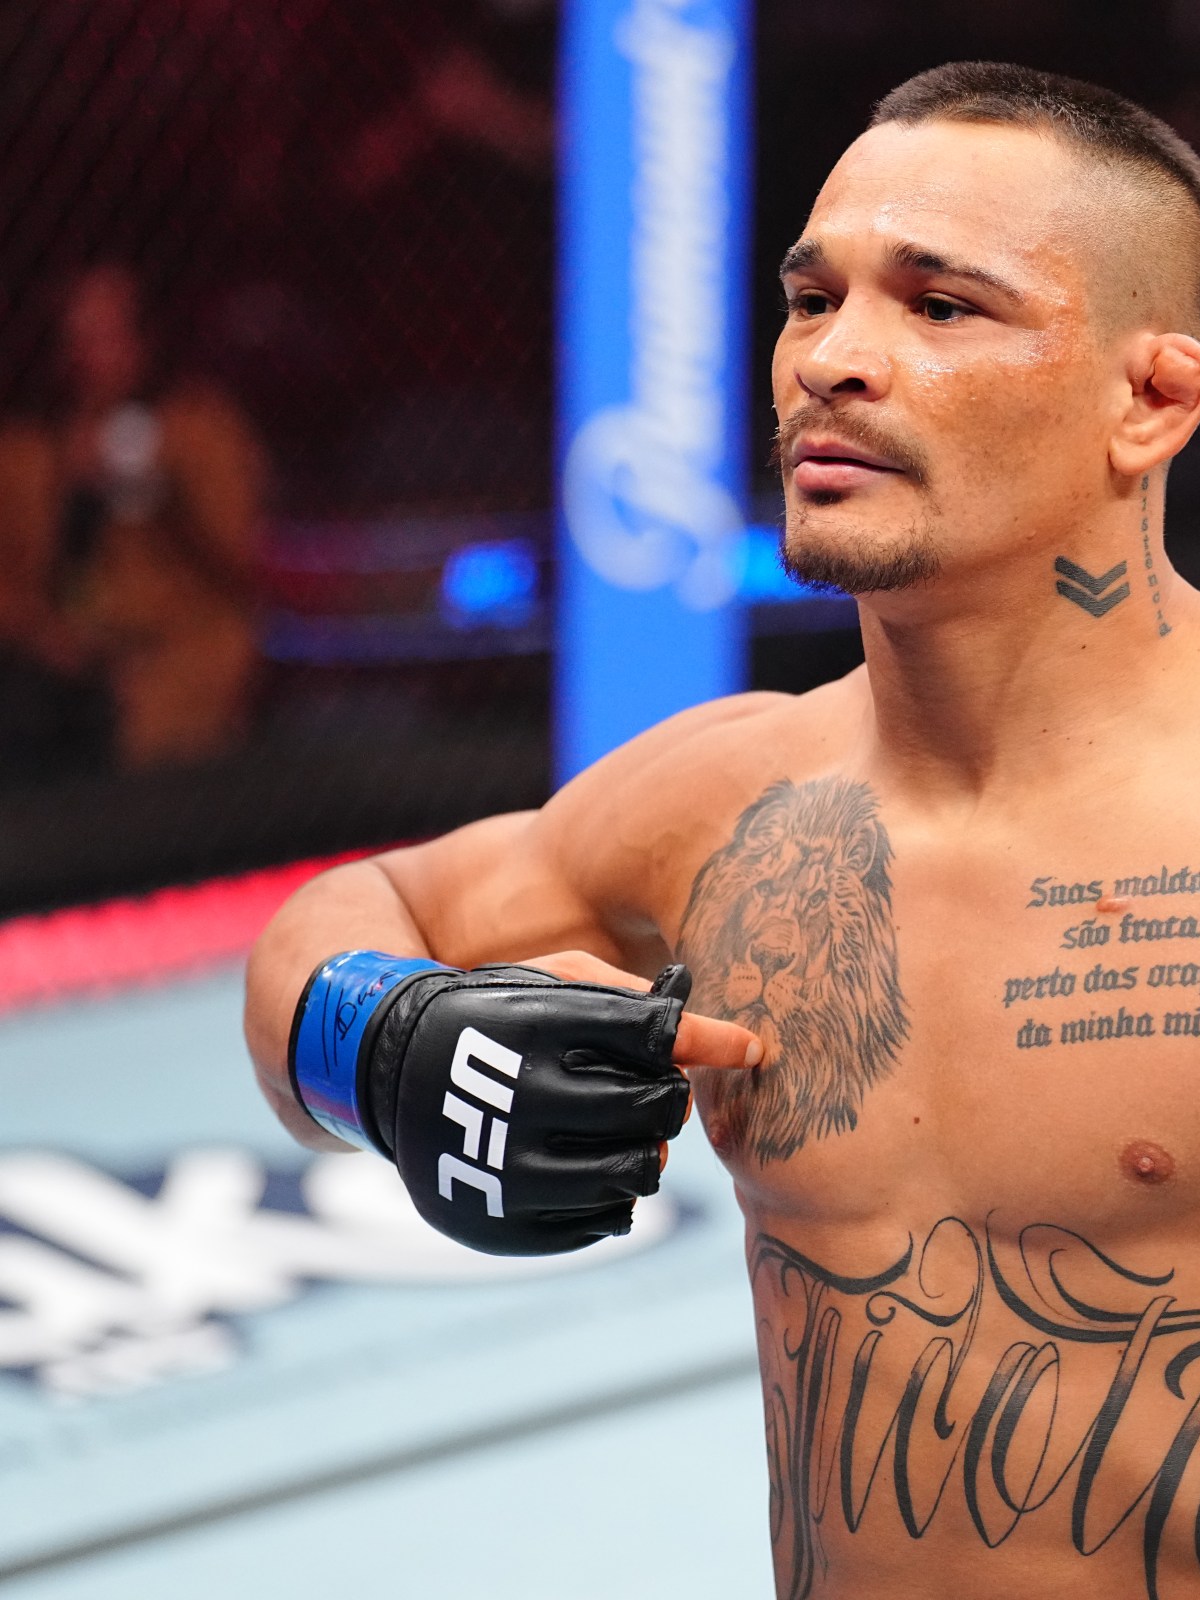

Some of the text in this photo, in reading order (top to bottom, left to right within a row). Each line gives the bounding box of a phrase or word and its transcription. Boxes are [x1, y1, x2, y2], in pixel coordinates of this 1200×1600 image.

[1025, 877, 1103, 908] Suas
[1059, 918, 1111, 949] são
[1002, 966, 1076, 1008] perto
[1083, 963, 1140, 994] das
[1016, 1018, 1053, 1049] da
[1060, 1006, 1155, 1045] minha
[437, 1026, 523, 1219] UFC
